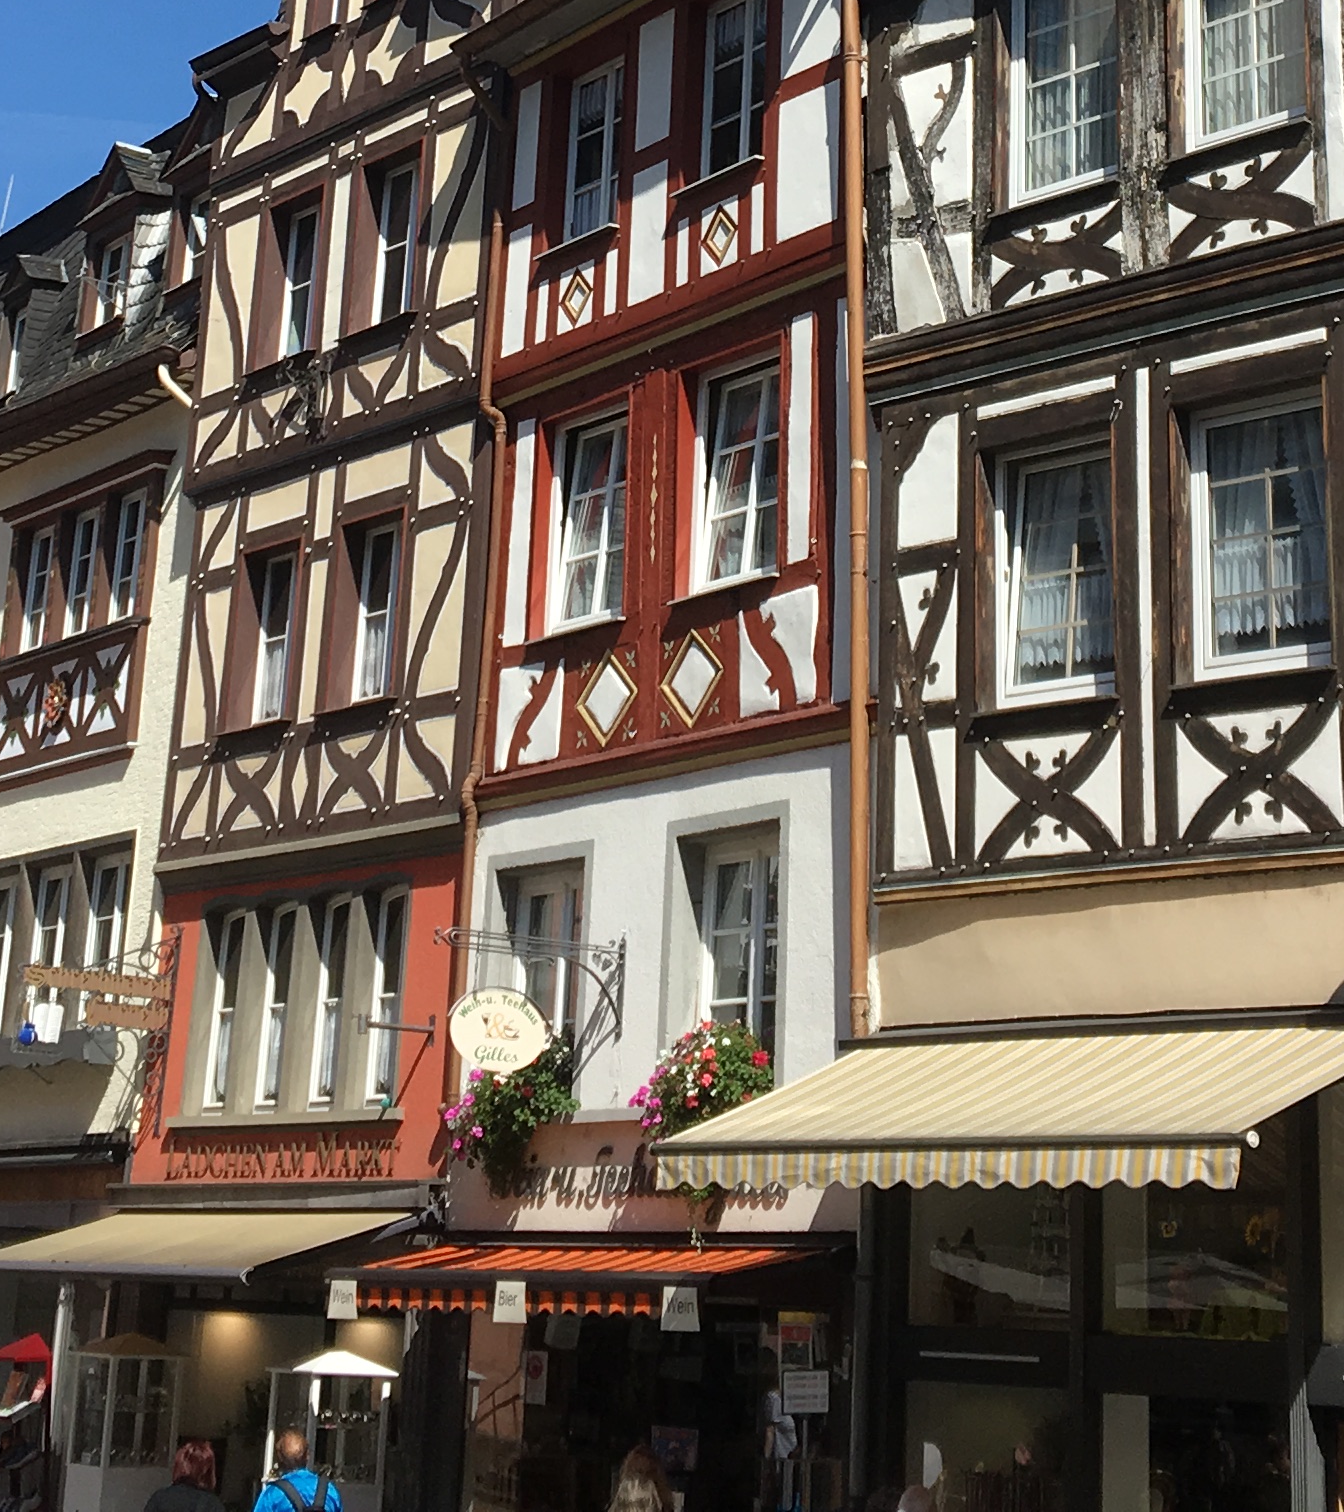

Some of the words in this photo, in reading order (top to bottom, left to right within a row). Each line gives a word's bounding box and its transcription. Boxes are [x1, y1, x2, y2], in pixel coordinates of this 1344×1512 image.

[474, 1045, 519, 1064] Gilles
[271, 1141, 307, 1178] AM
[310, 1131, 403, 1180] MARKT
[332, 1289, 354, 1305] Wein
[498, 1290, 518, 1307] Bier
[666, 1297, 695, 1314] Wein
